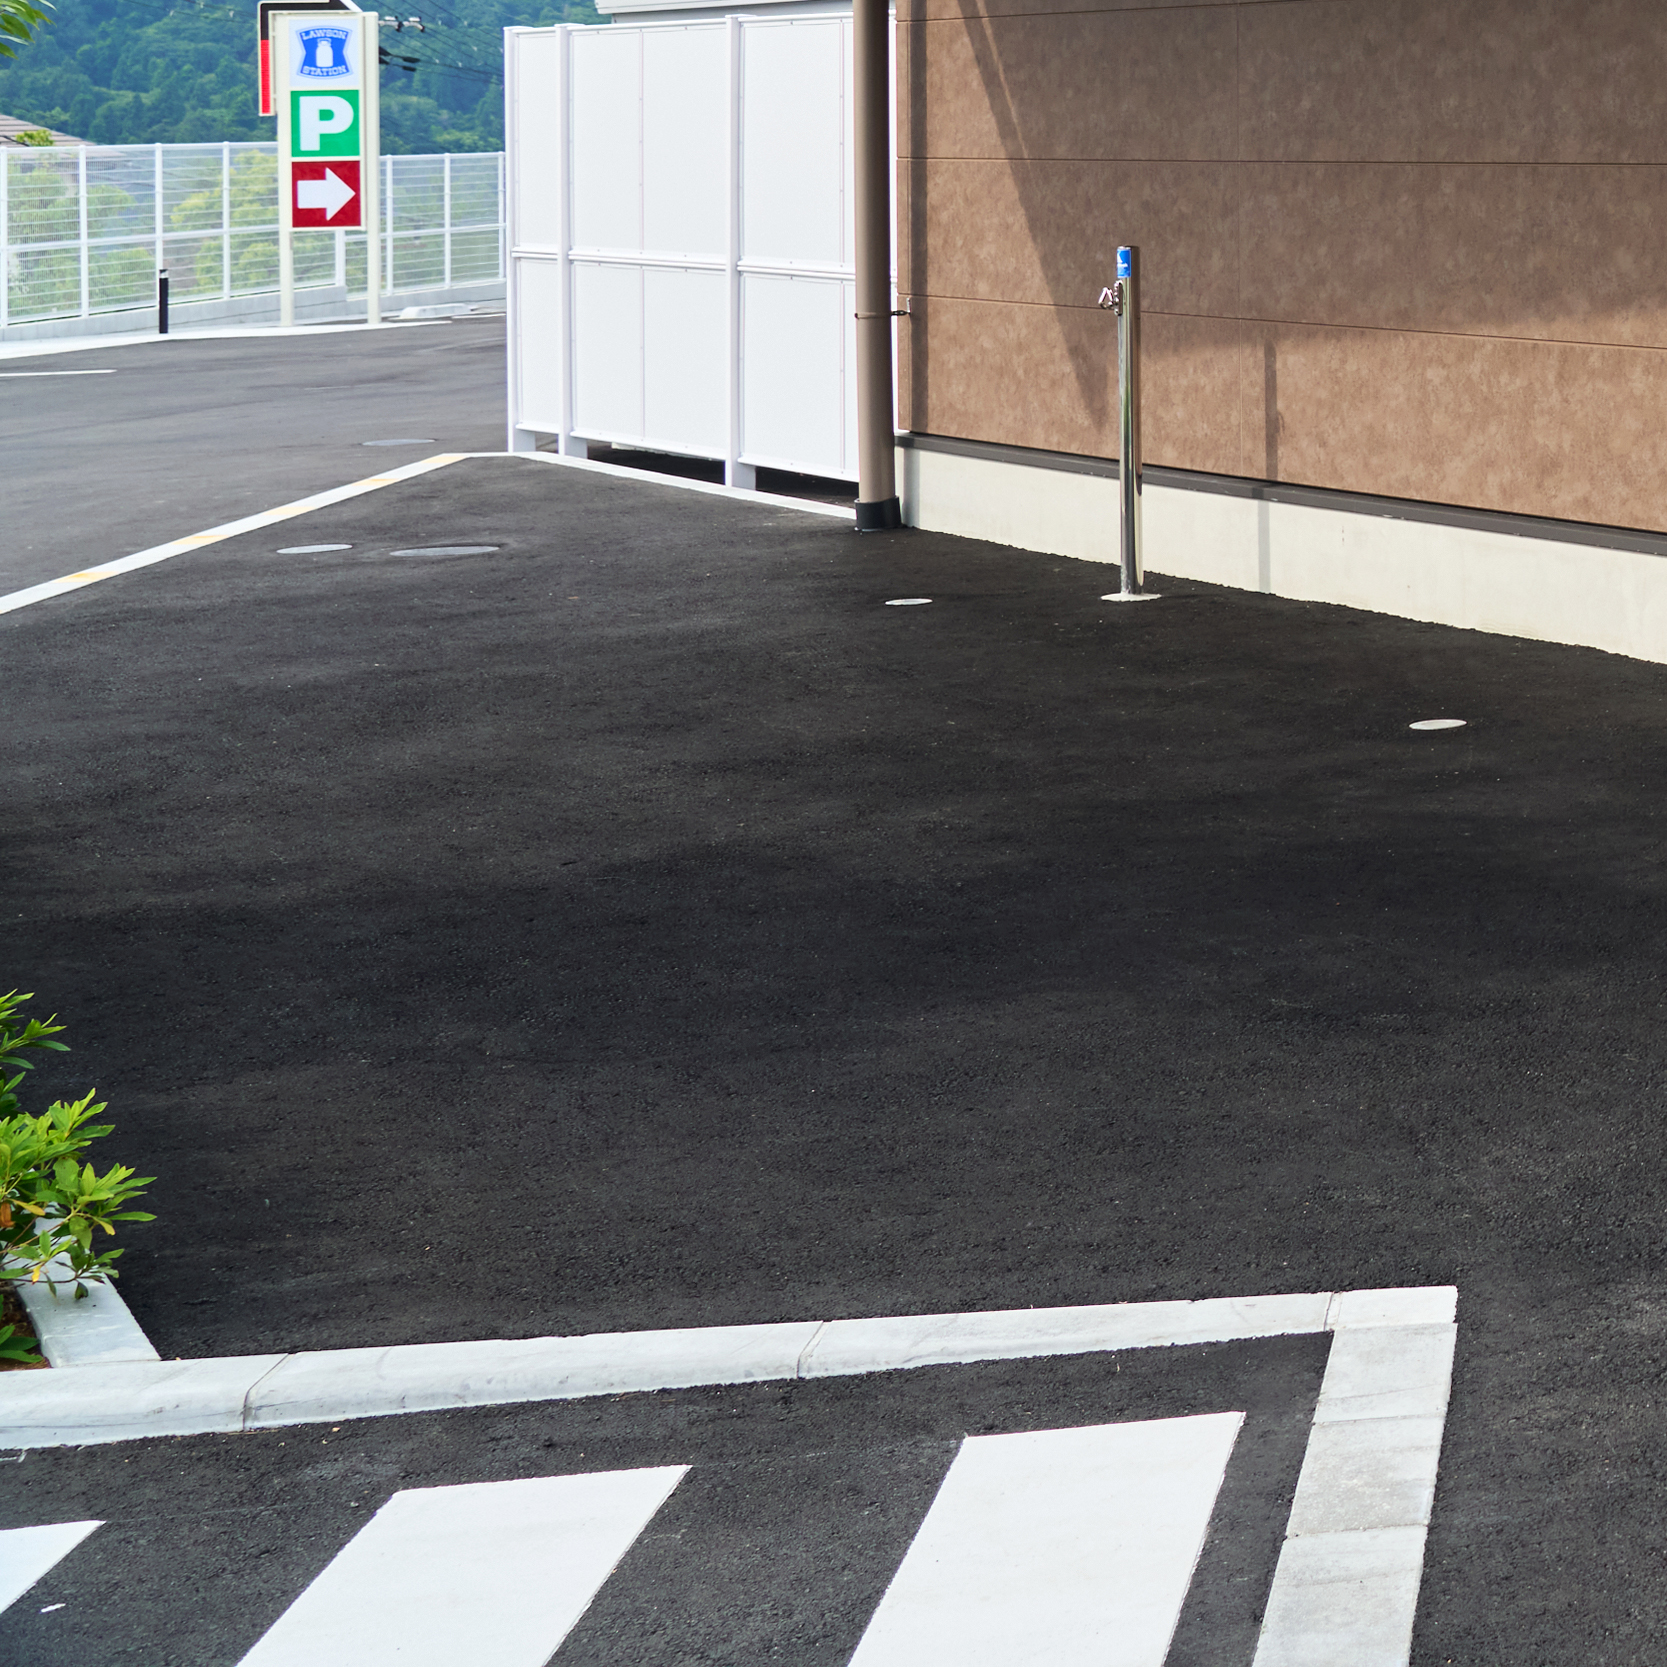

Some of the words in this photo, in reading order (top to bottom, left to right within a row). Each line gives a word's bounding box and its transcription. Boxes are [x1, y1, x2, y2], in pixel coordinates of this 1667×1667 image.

[302, 29, 347, 40] LAWSON
[302, 65, 347, 76] STATION
[299, 95, 355, 152] P
